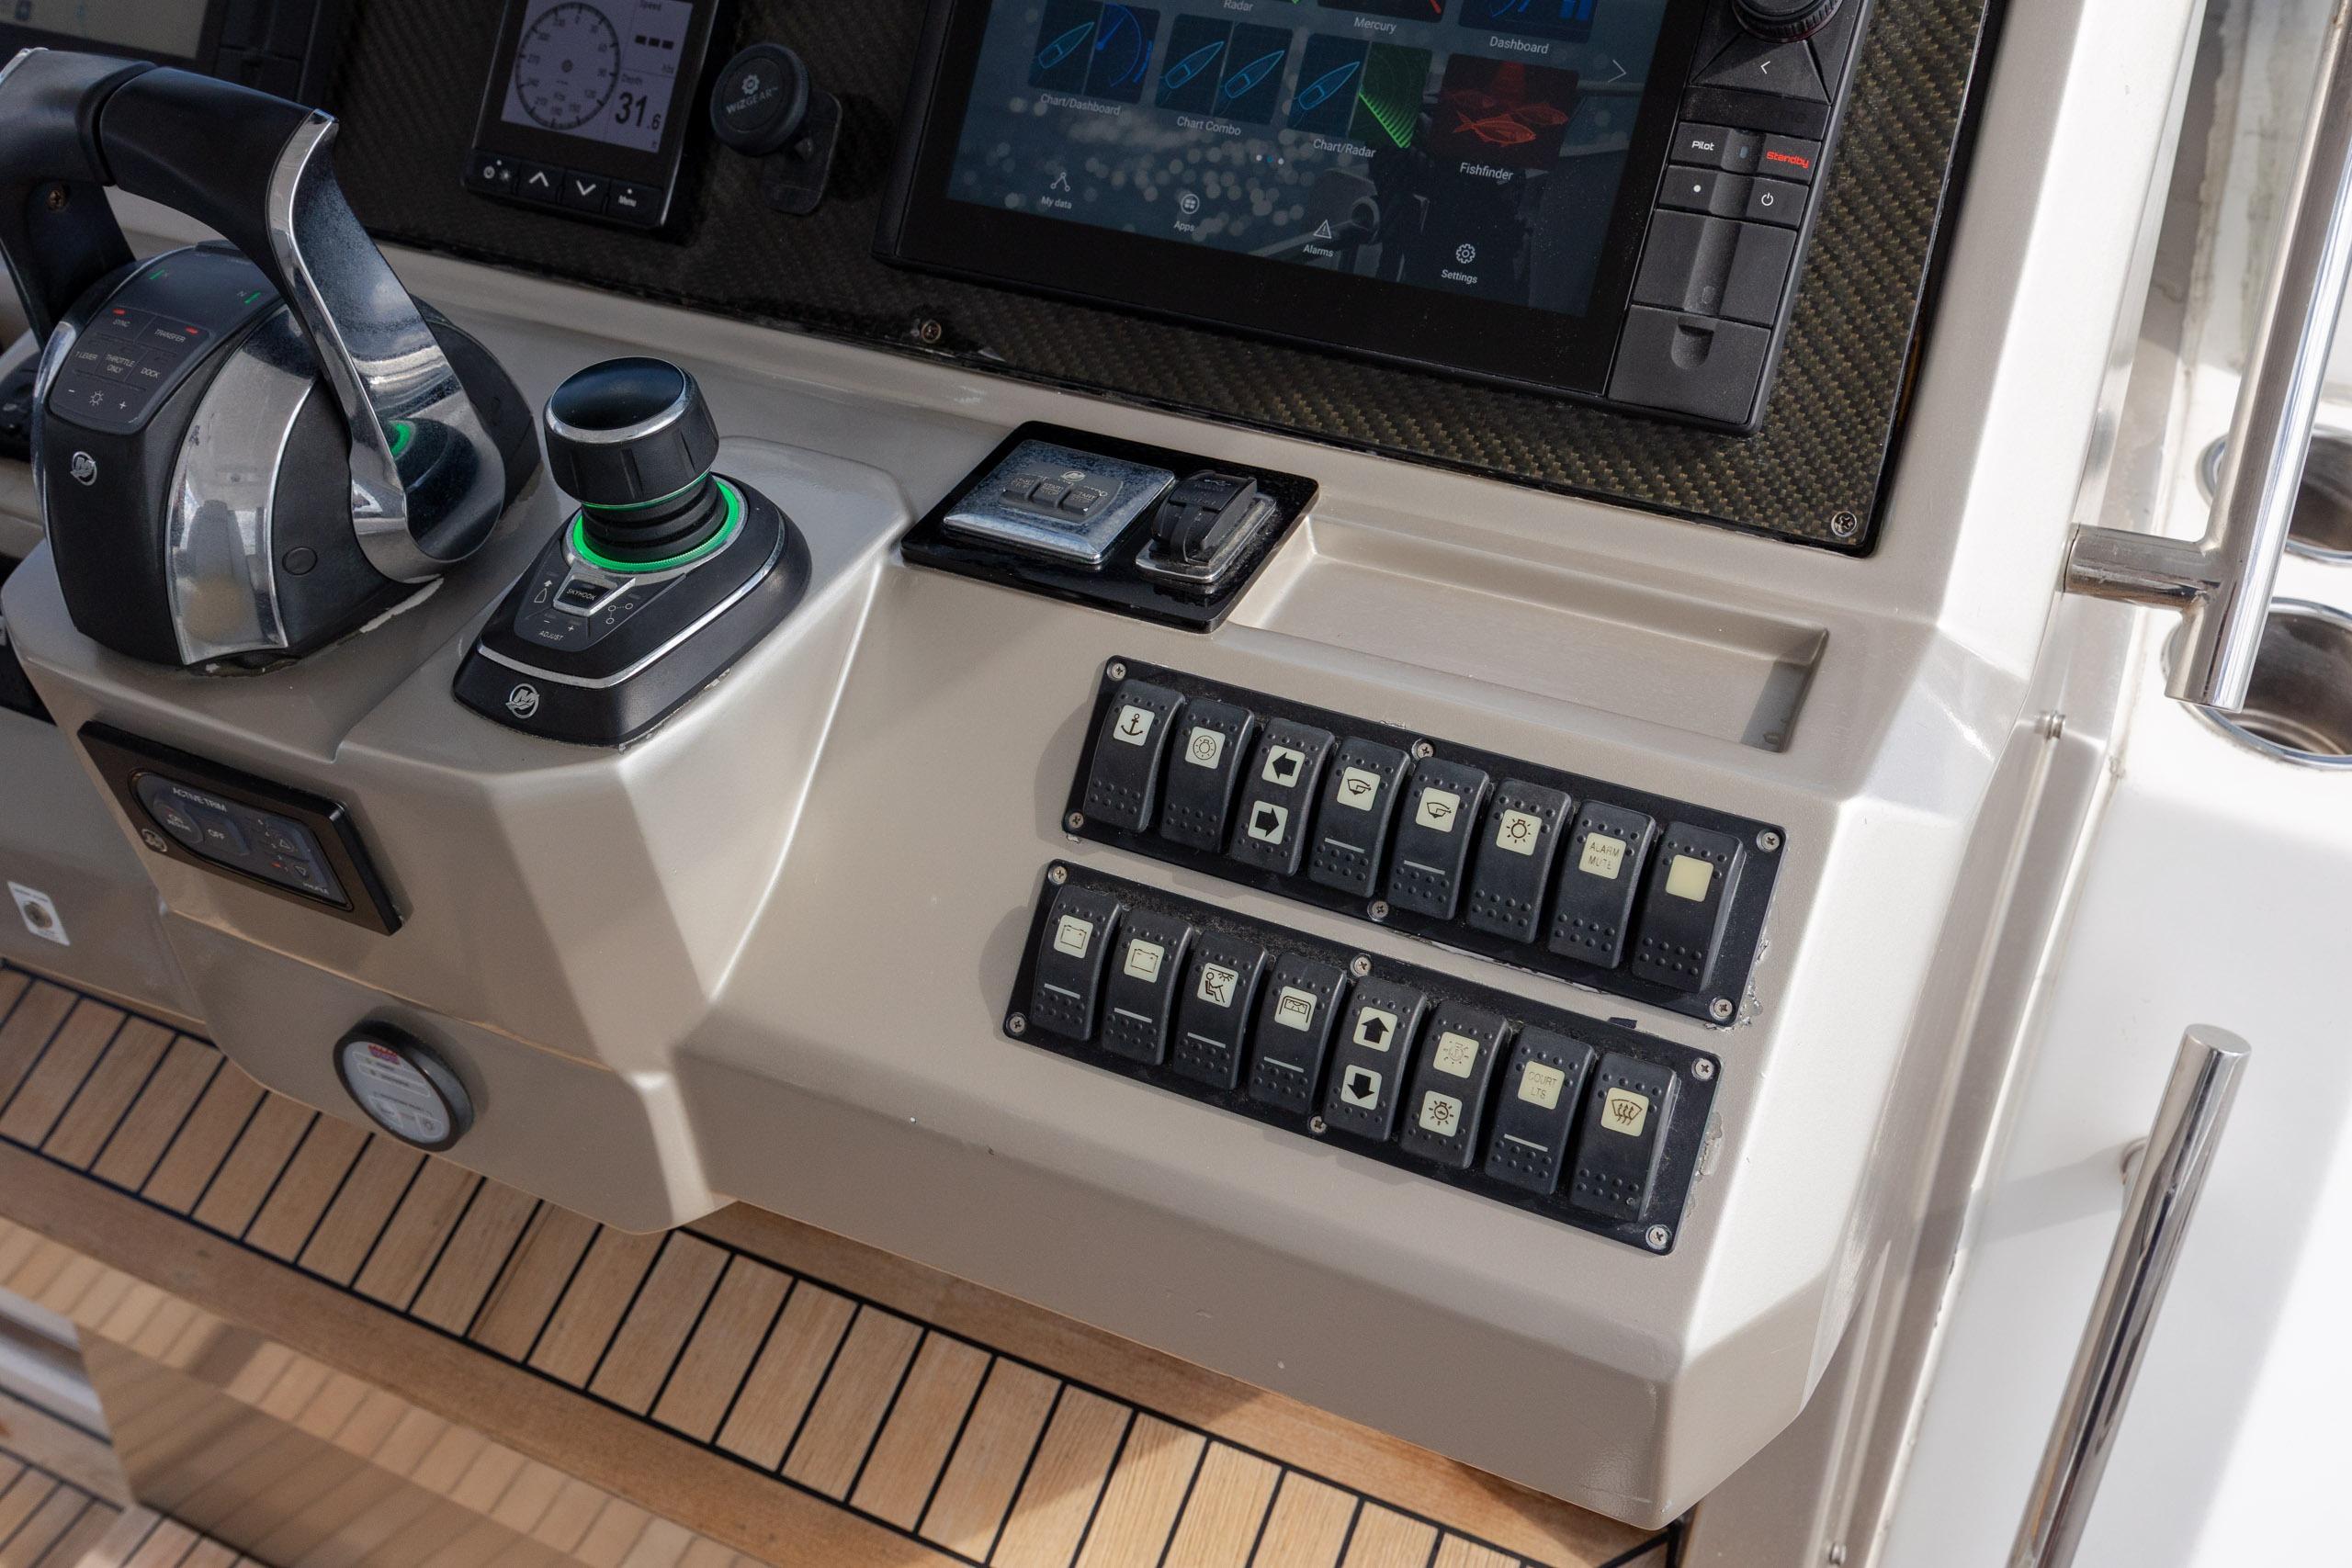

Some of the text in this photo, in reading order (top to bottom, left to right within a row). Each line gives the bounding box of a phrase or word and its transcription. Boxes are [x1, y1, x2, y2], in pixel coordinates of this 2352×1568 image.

[1224, 0, 1253, 12] Radar
[1353, 17, 1396, 35] Mercury
[1489, 36, 1550, 55] Dashboard
[1040, 94, 1121, 116] Chart/Dashboard
[1177, 116, 1241, 136] Chart Combo
[1313, 139, 1376, 159] Chart/Radar
[1691, 141, 1715, 152] Pilot
[1766, 151, 1810, 169] Standby
[1459, 162, 1514, 181] Fishfinder
[1041, 196, 1072, 210] My data
[1174, 220, 1195, 233] Apps
[1303, 243, 1334, 258] Alarms
[1441, 268, 1478, 285] Settings
[154, 328, 187, 343] TRANSFER
[80, 352, 98, 361] LEVER
[106, 354, 136, 367] THROTTLE
[107, 365, 124, 374] ONLY
[140, 367, 162, 378] DOCK
[566, 588, 597, 601] SKYHOOK
[538, 630, 565, 641] ADJUST
[1589, 841, 1620, 857] ALARM
[1529, 1071, 1557, 1087] COURT
[1531, 1088, 1547, 1100] LTS
